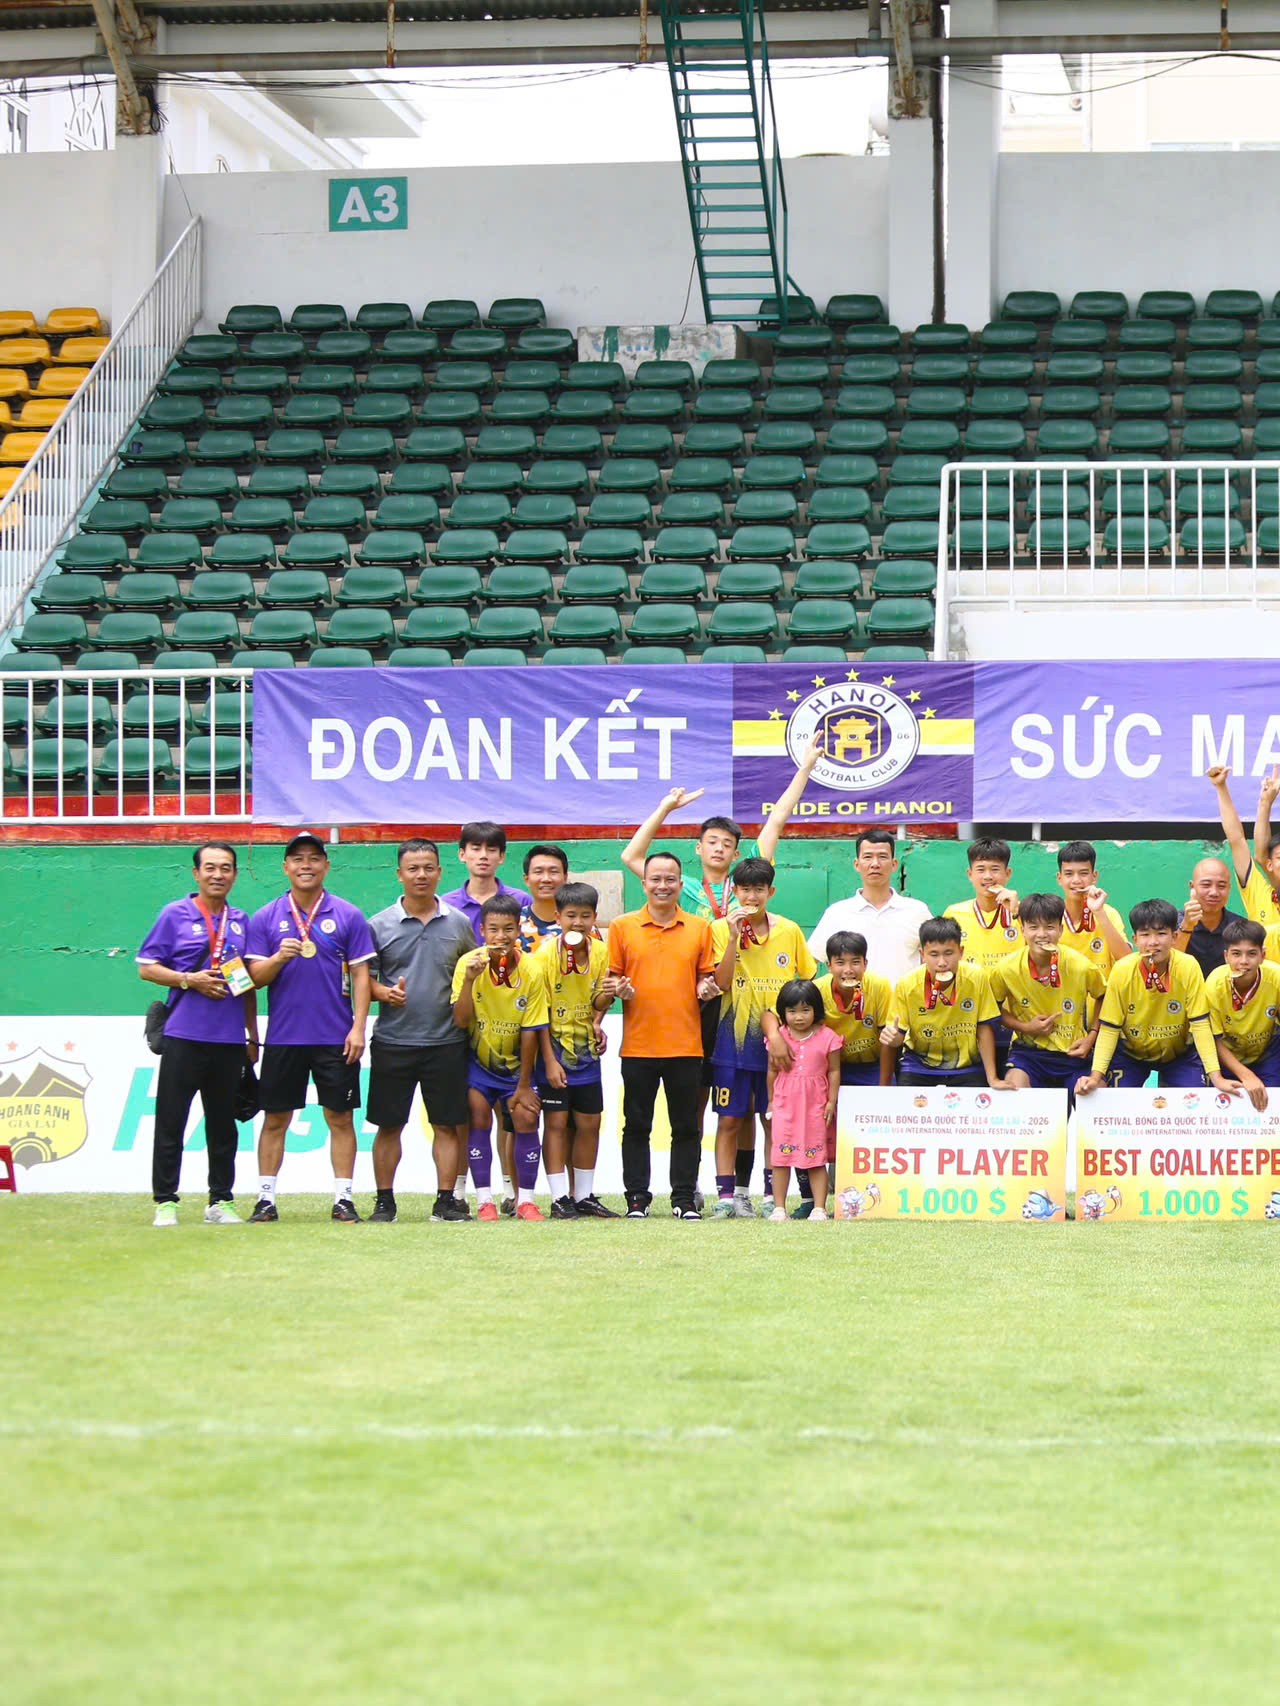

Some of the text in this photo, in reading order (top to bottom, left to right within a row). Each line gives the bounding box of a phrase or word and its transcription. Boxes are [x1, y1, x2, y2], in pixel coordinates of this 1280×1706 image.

[337, 185, 400, 225] A3
[808, 688, 897, 715] HANOI
[308, 688, 687, 782] ĐOÀN KẾT
[1010, 696, 1162, 779] SỨC
[812, 758, 899, 782] OOTBALL CLUB
[762, 801, 953, 816] PIDE OF HANOI
[715, 1086, 730, 1107] 18
[8, 1120, 31, 1128] GIA
[44, 1104, 70, 1120] ANH
[855, 1114, 893, 1124] FESTIVAL
[1028, 1117, 1049, 1126] 2026
[1093, 1116, 1132, 1126] FESTIVAL
[852, 1147, 1049, 1176] BEST PLAYER
[1083, 1149, 1141, 1176] BEST
[897, 1187, 1007, 1216] 1.000 $
[1139, 1187, 1249, 1217] 1.000 $
